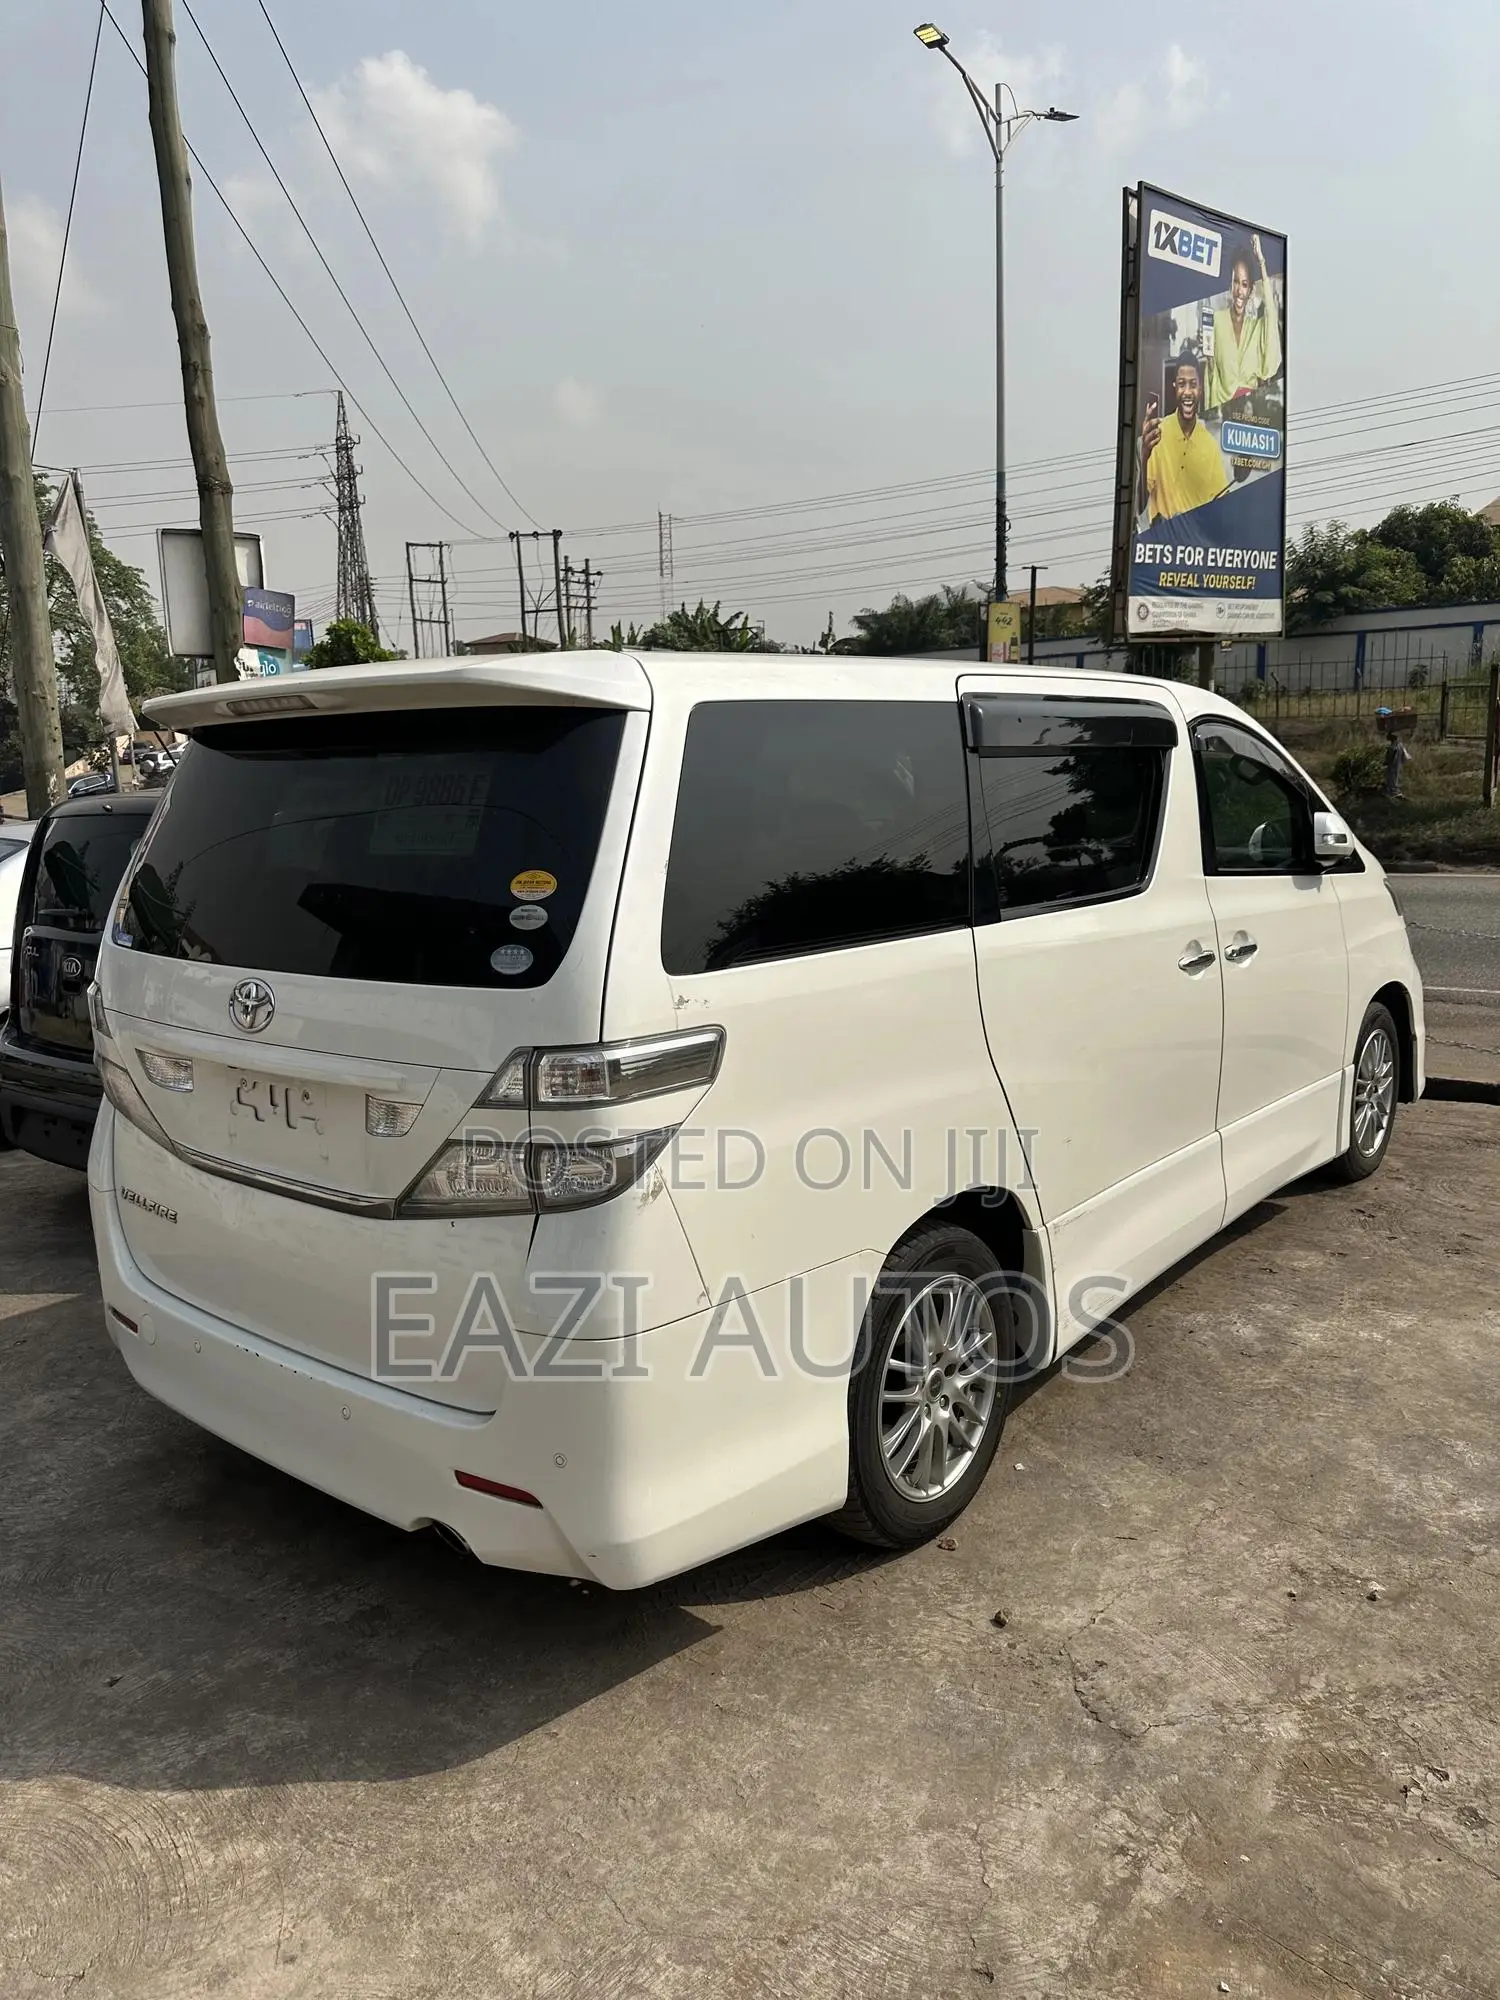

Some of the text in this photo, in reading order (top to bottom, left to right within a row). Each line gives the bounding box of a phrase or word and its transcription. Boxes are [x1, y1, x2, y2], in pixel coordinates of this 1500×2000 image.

[1153, 220, 1218, 267] 1XBET
[1227, 428, 1275, 452] KUMASI1
[1135, 543, 1278, 569] BETS FOR EVERYONE
[1159, 571, 1256, 590] REVEAL YOURSELF!
